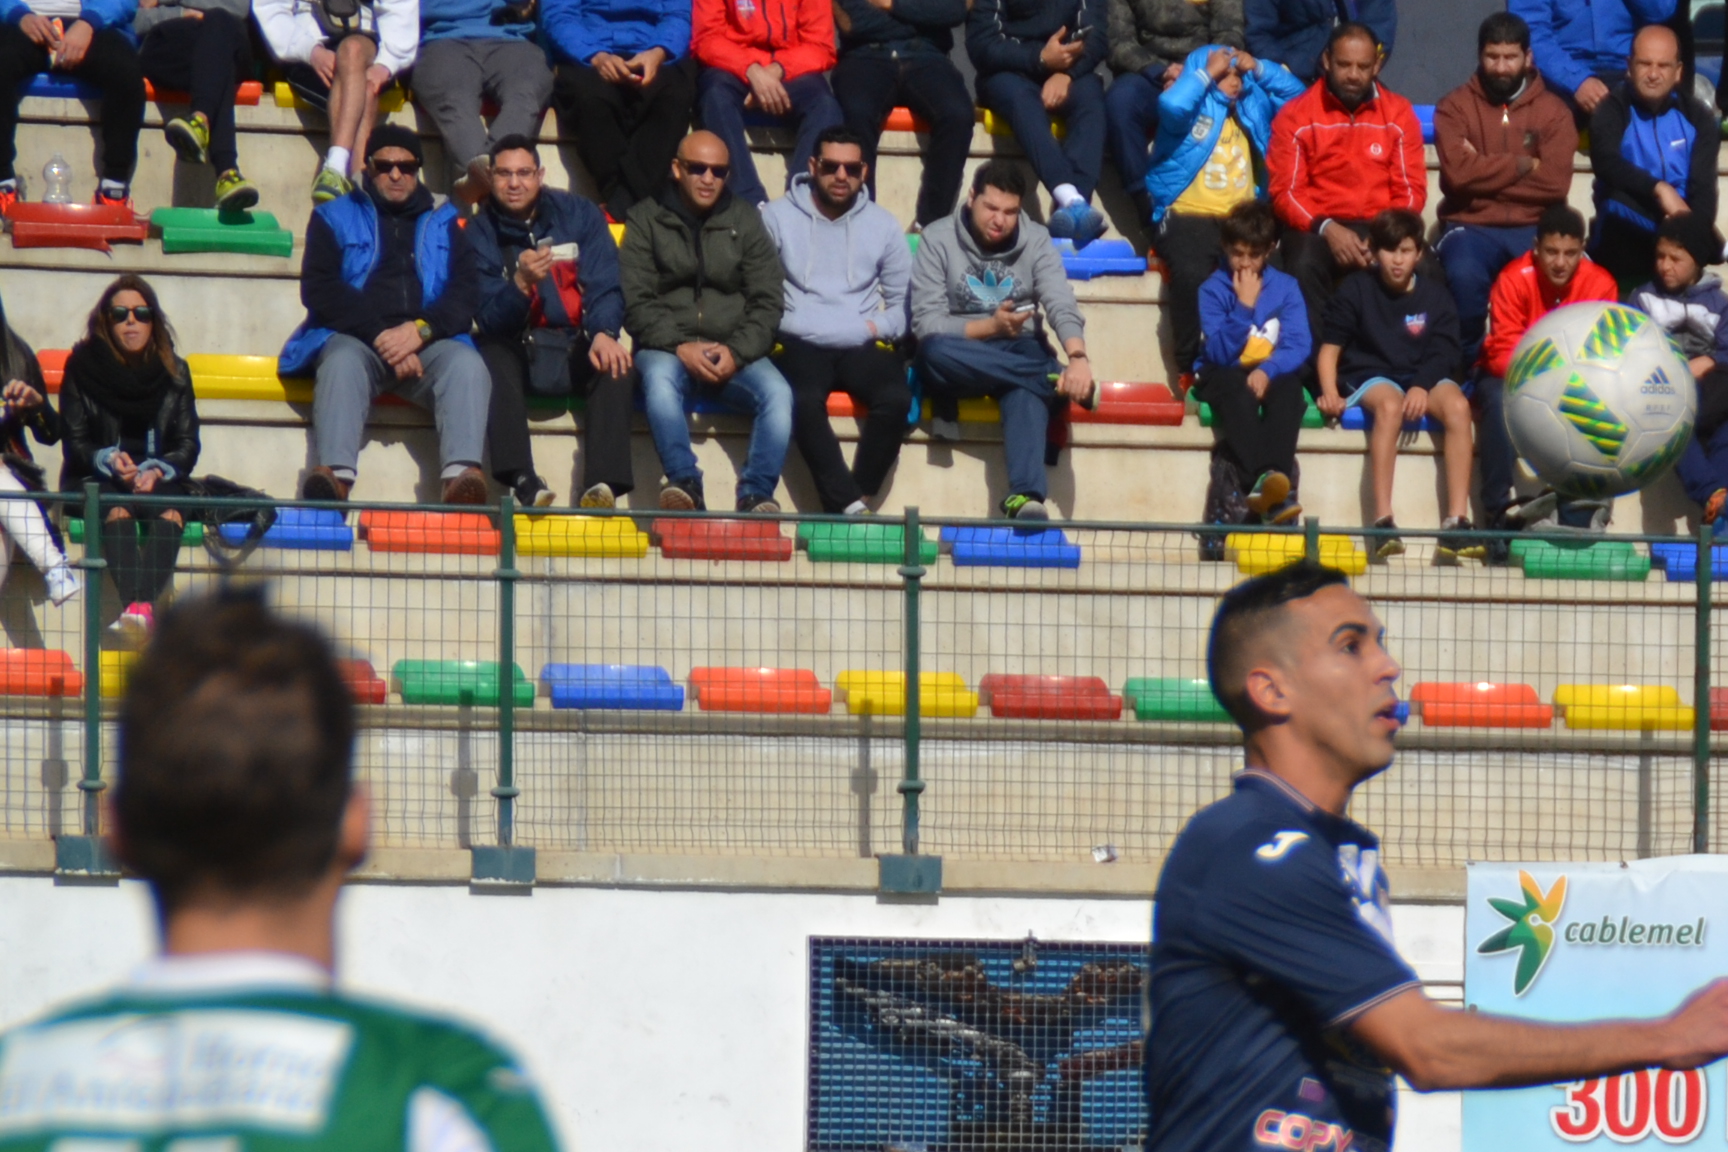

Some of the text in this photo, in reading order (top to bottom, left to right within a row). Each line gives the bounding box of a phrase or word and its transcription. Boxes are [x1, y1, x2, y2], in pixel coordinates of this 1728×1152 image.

[1641, 383, 1676, 395] adidas
[1564, 914, 1707, 946] cablemel
[1554, 1067, 1700, 1138] 300
